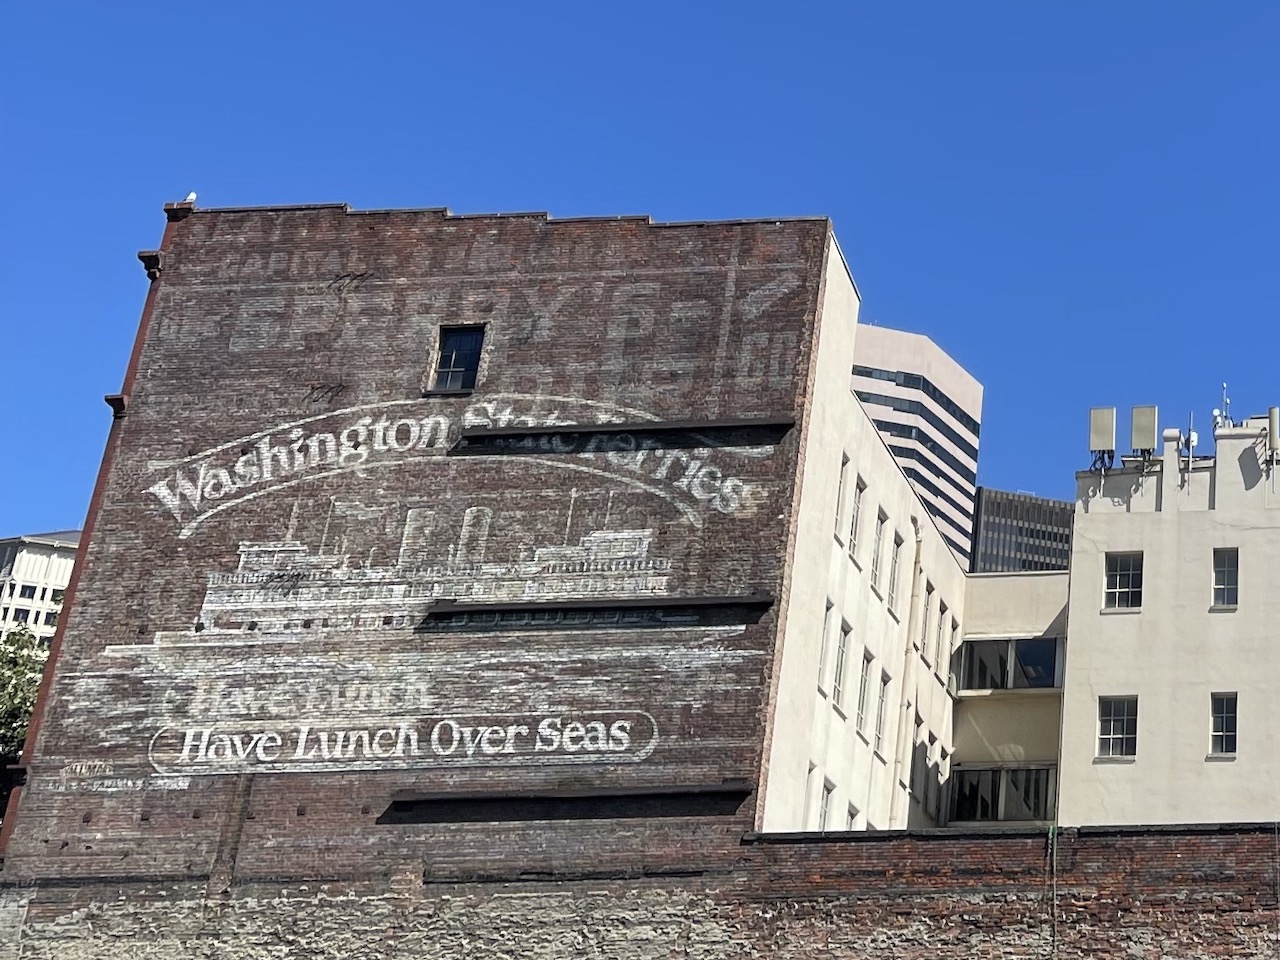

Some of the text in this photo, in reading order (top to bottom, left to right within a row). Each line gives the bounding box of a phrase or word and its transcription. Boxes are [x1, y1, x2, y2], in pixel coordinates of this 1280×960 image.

[141, 413, 451, 525] Washington
[176, 717, 632, 763] Have Lunch Over Seas
